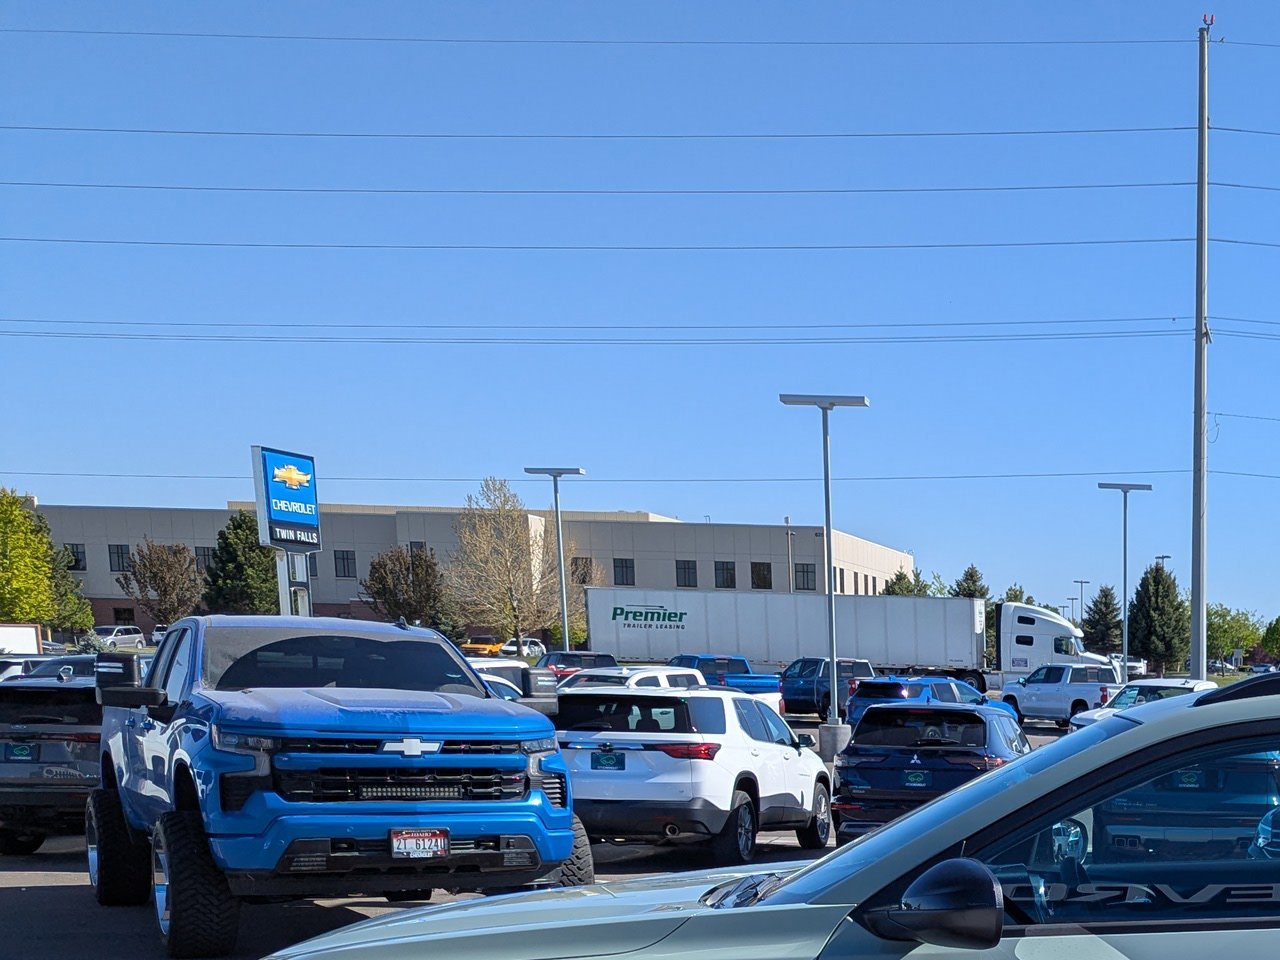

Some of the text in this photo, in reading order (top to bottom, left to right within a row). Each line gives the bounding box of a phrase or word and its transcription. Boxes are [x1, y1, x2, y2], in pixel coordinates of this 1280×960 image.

[272, 499, 316, 515] CHEVROLET
[275, 527, 318, 543] TWIN FALLS
[611, 606, 687, 622] Premier
[396, 838, 407, 850] 2T
